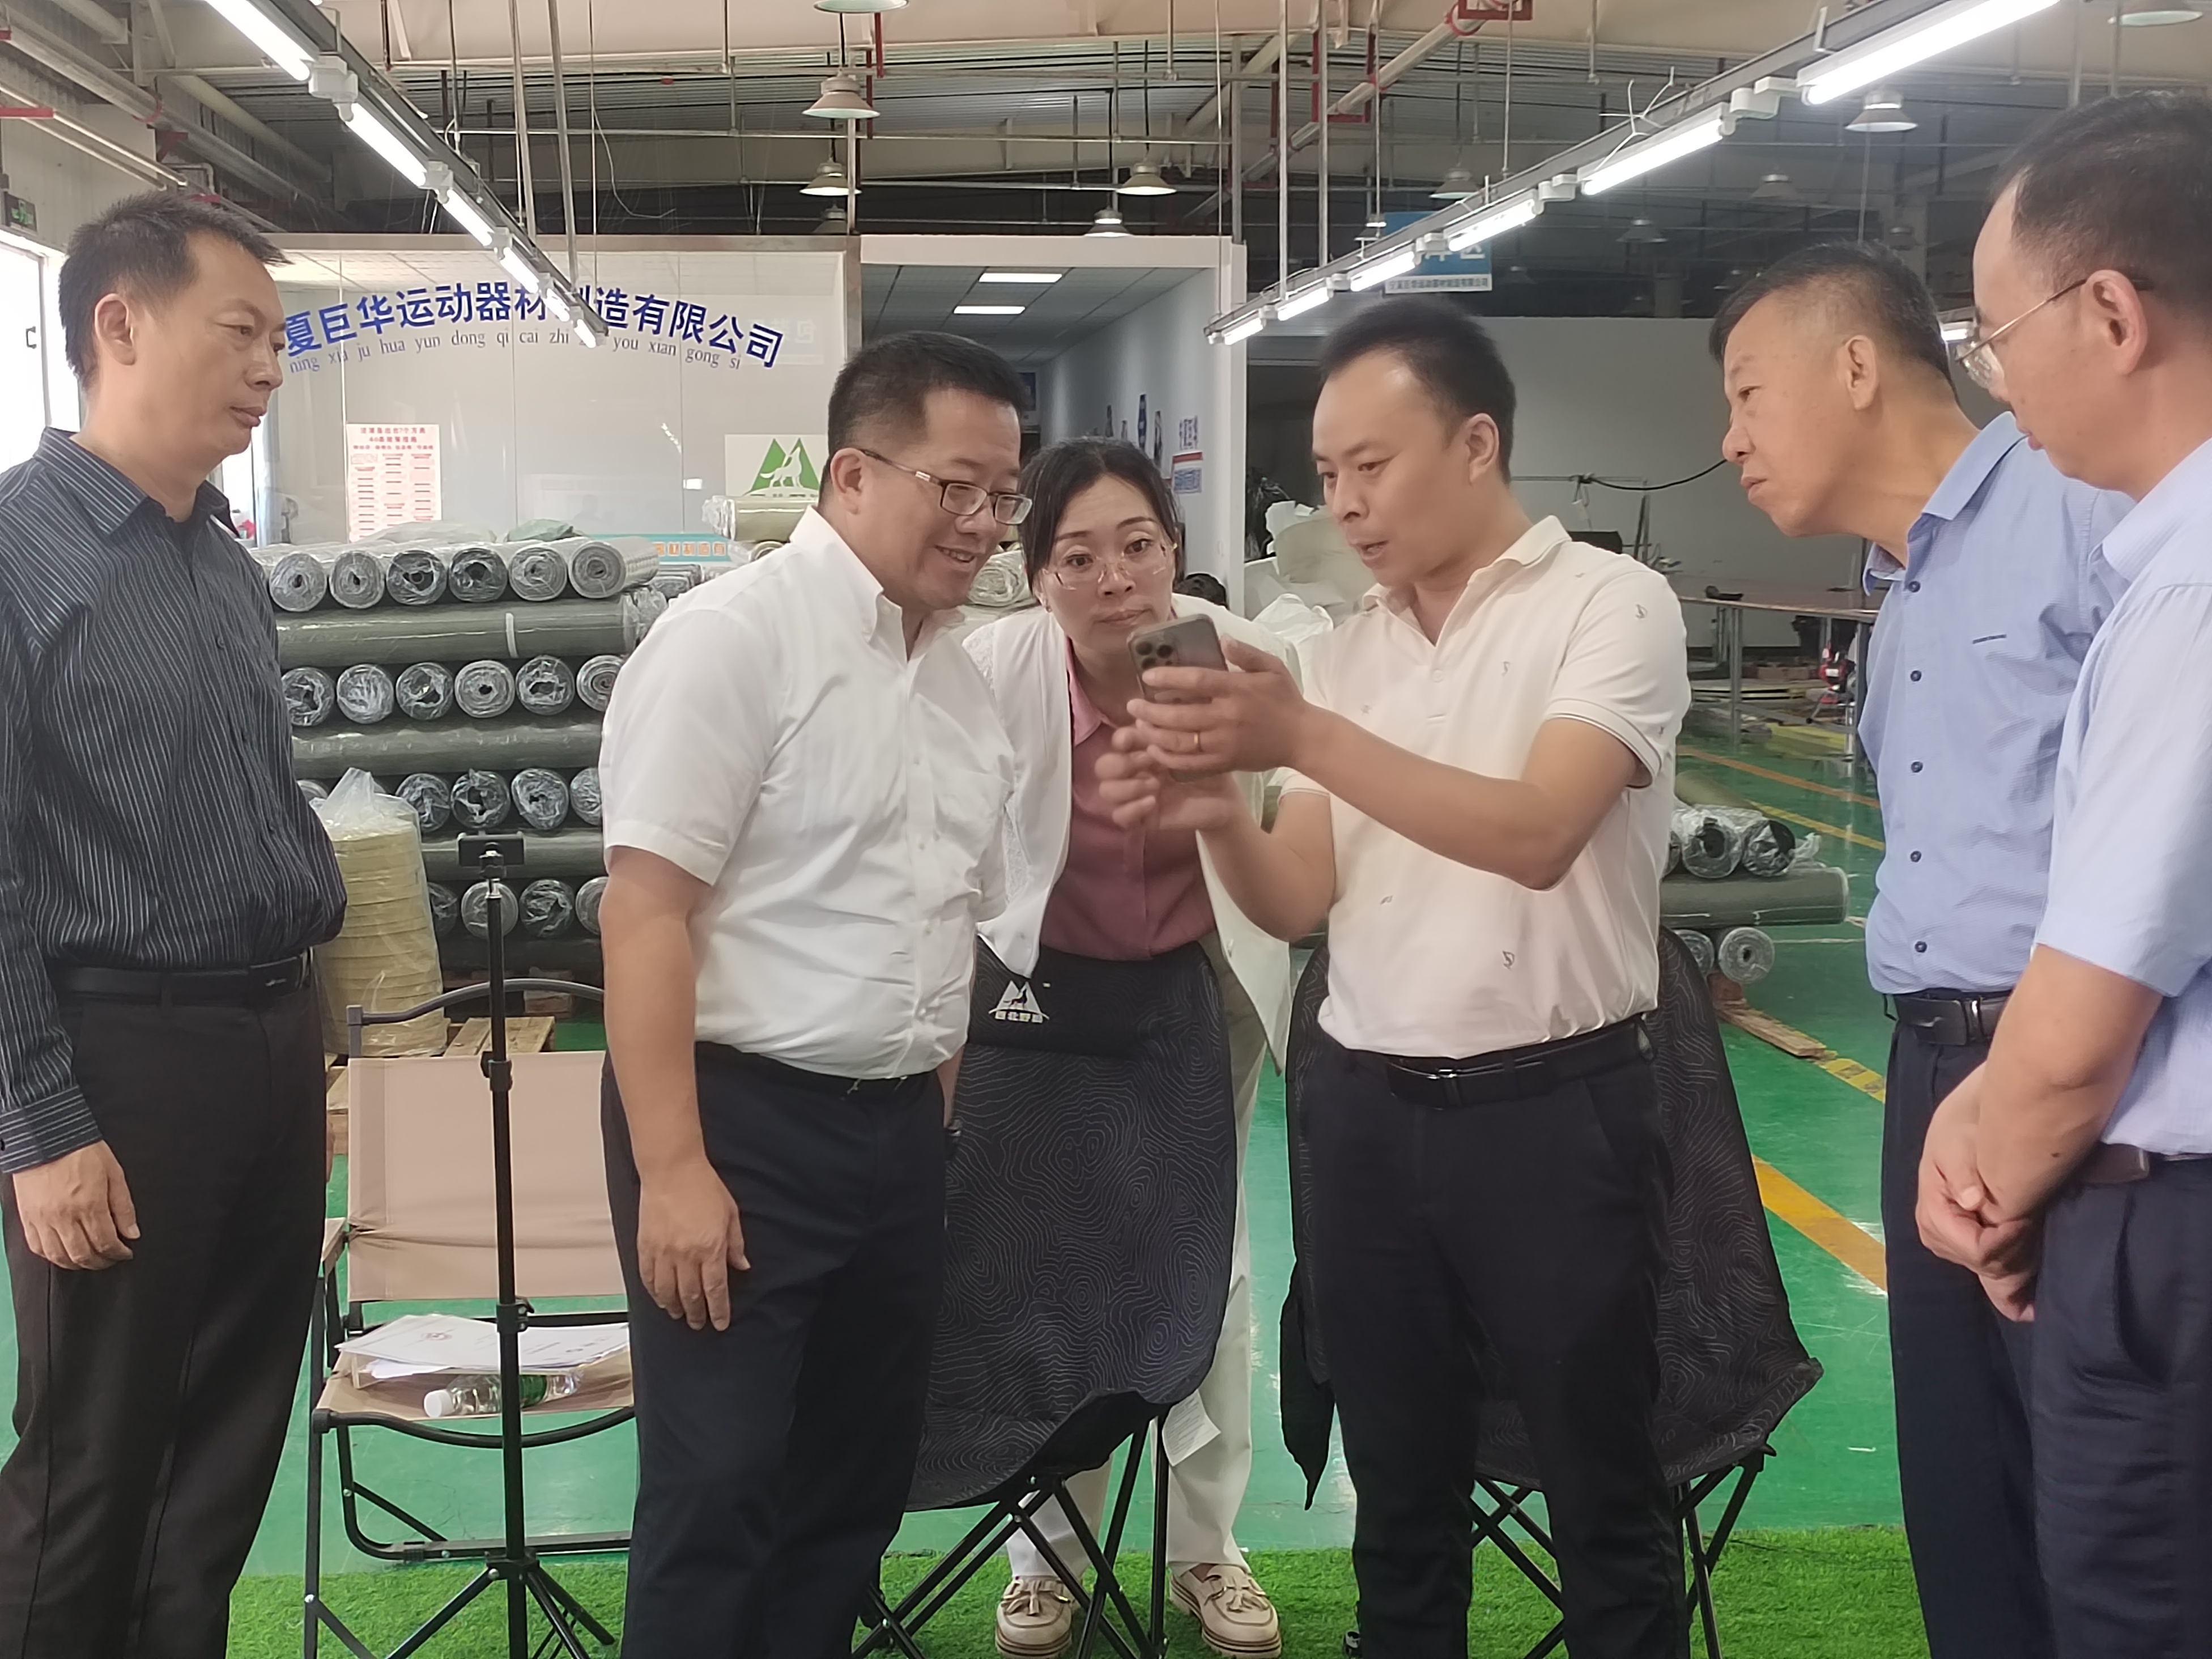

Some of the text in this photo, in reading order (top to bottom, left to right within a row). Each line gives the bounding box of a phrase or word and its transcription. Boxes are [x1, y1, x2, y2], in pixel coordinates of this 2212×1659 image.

[286, 282, 783, 368] 夏巨华运动器材造有限公司
[290, 356, 320, 373] ning
[356, 342, 371, 363] ju
[379, 339, 406, 354] hua
[414, 335, 441, 354] yun
[451, 329, 486, 349] dong
[496, 327, 509, 348] qi
[519, 327, 539, 344] cai
[549, 328, 569, 344] zhi
[612, 337, 639, 352] you
[648, 338, 677, 356] xian
[684, 347, 721, 368] gong
[729, 354, 741, 369] si
